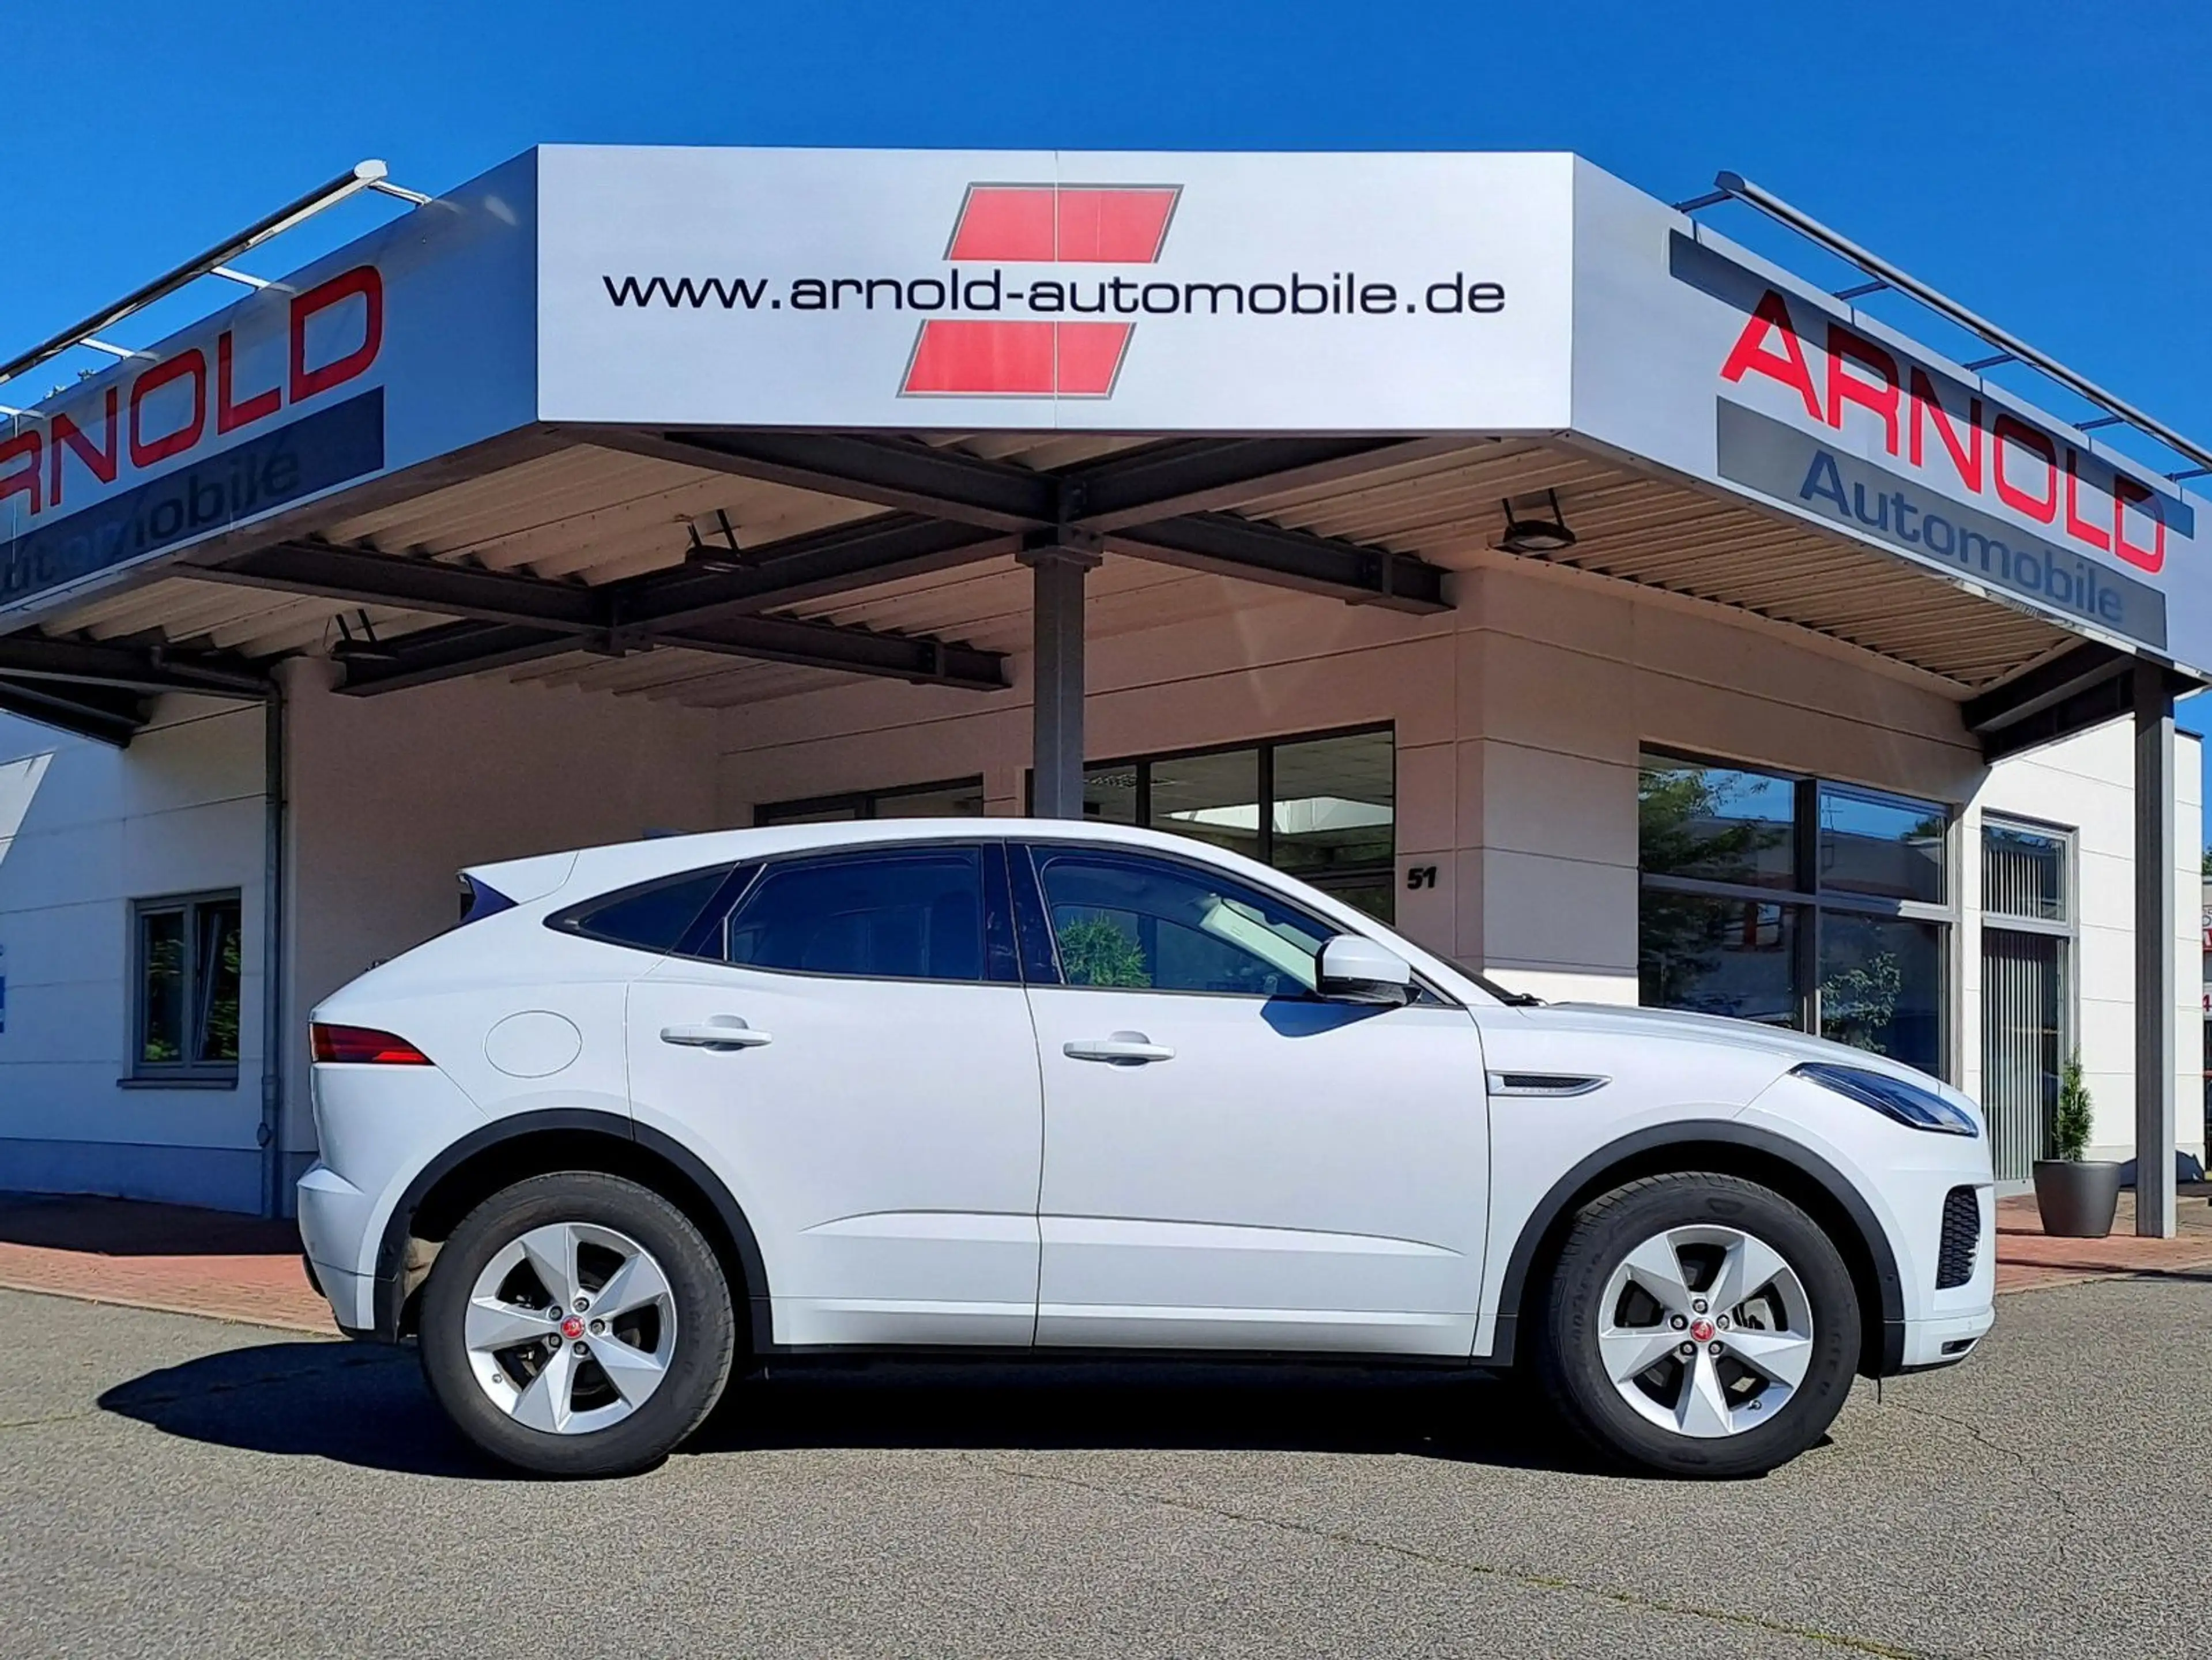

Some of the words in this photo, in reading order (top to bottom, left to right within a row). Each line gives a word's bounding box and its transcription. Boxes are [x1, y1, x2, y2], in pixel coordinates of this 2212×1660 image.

[602, 269, 1506, 315] www.arnold-automobile.de
[1720, 289, 2165, 574] ARNOLD
[0, 448, 299, 595] utomobile
[1799, 450, 2123, 623] Automobile
[1407, 866, 1437, 889] 51
